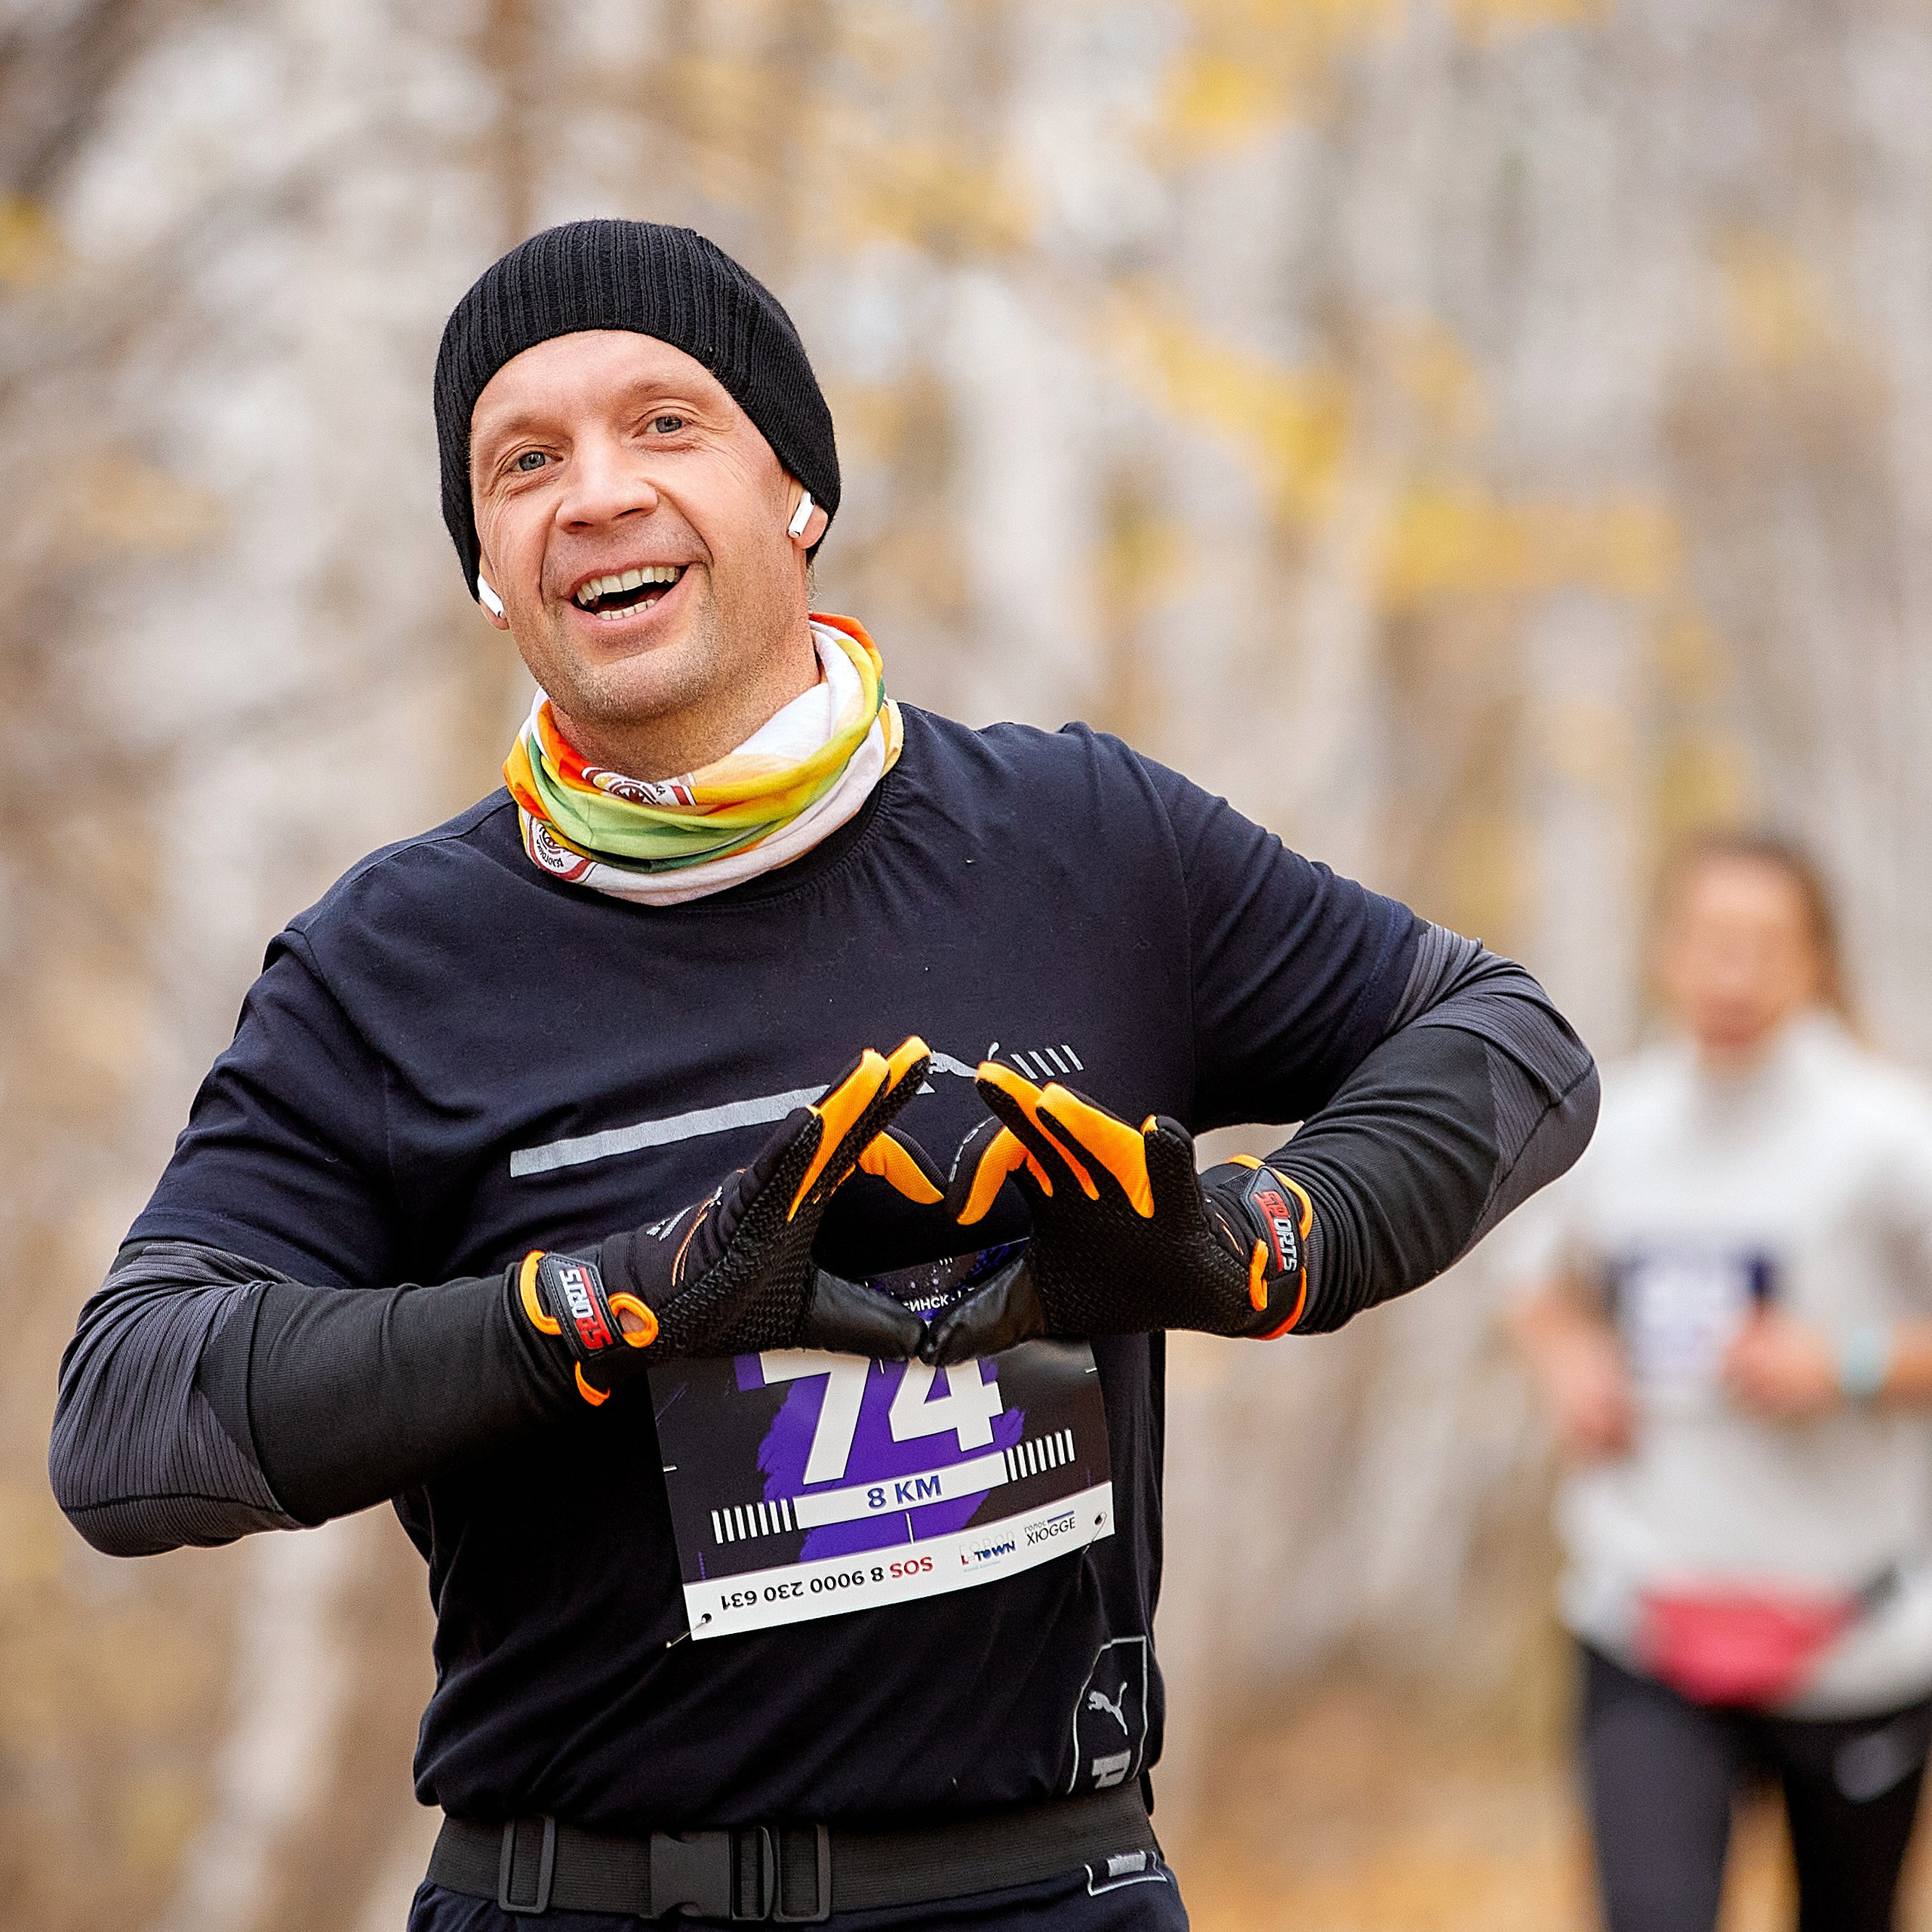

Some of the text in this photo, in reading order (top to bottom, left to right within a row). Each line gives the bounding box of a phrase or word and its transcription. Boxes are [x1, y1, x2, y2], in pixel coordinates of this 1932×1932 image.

[1253, 1189, 1298, 1272] SPORTS
[558, 1266, 613, 1350] SPORTS
[759, 1346, 1004, 1486] 74
[866, 1487, 887, 1511] 8
[721, 1556, 934, 1611] SOS 8 9000 230 631
